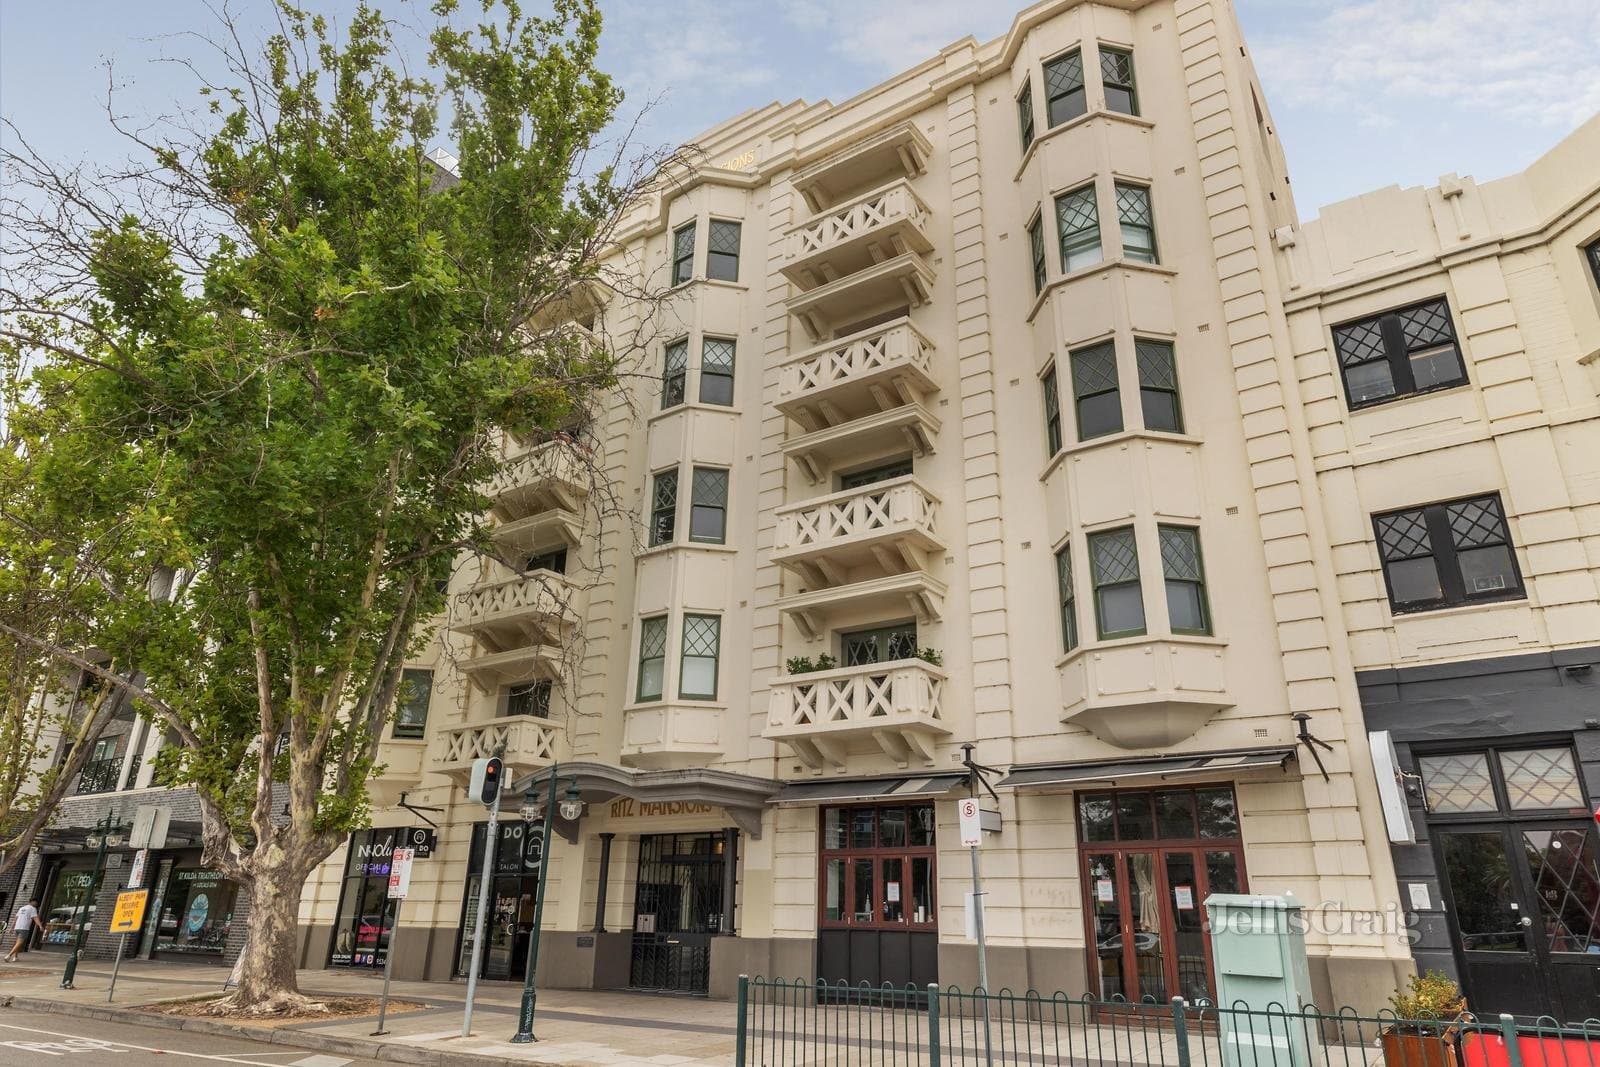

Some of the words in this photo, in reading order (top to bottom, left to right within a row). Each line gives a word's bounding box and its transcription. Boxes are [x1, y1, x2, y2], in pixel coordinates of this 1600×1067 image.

[610, 797, 635, 818] RITZ
[503, 826, 523, 839] DO
[184, 872, 197, 880] KILDA
[197, 872, 224, 880] TRIATHLON
[122, 910, 134, 918] OPEN
